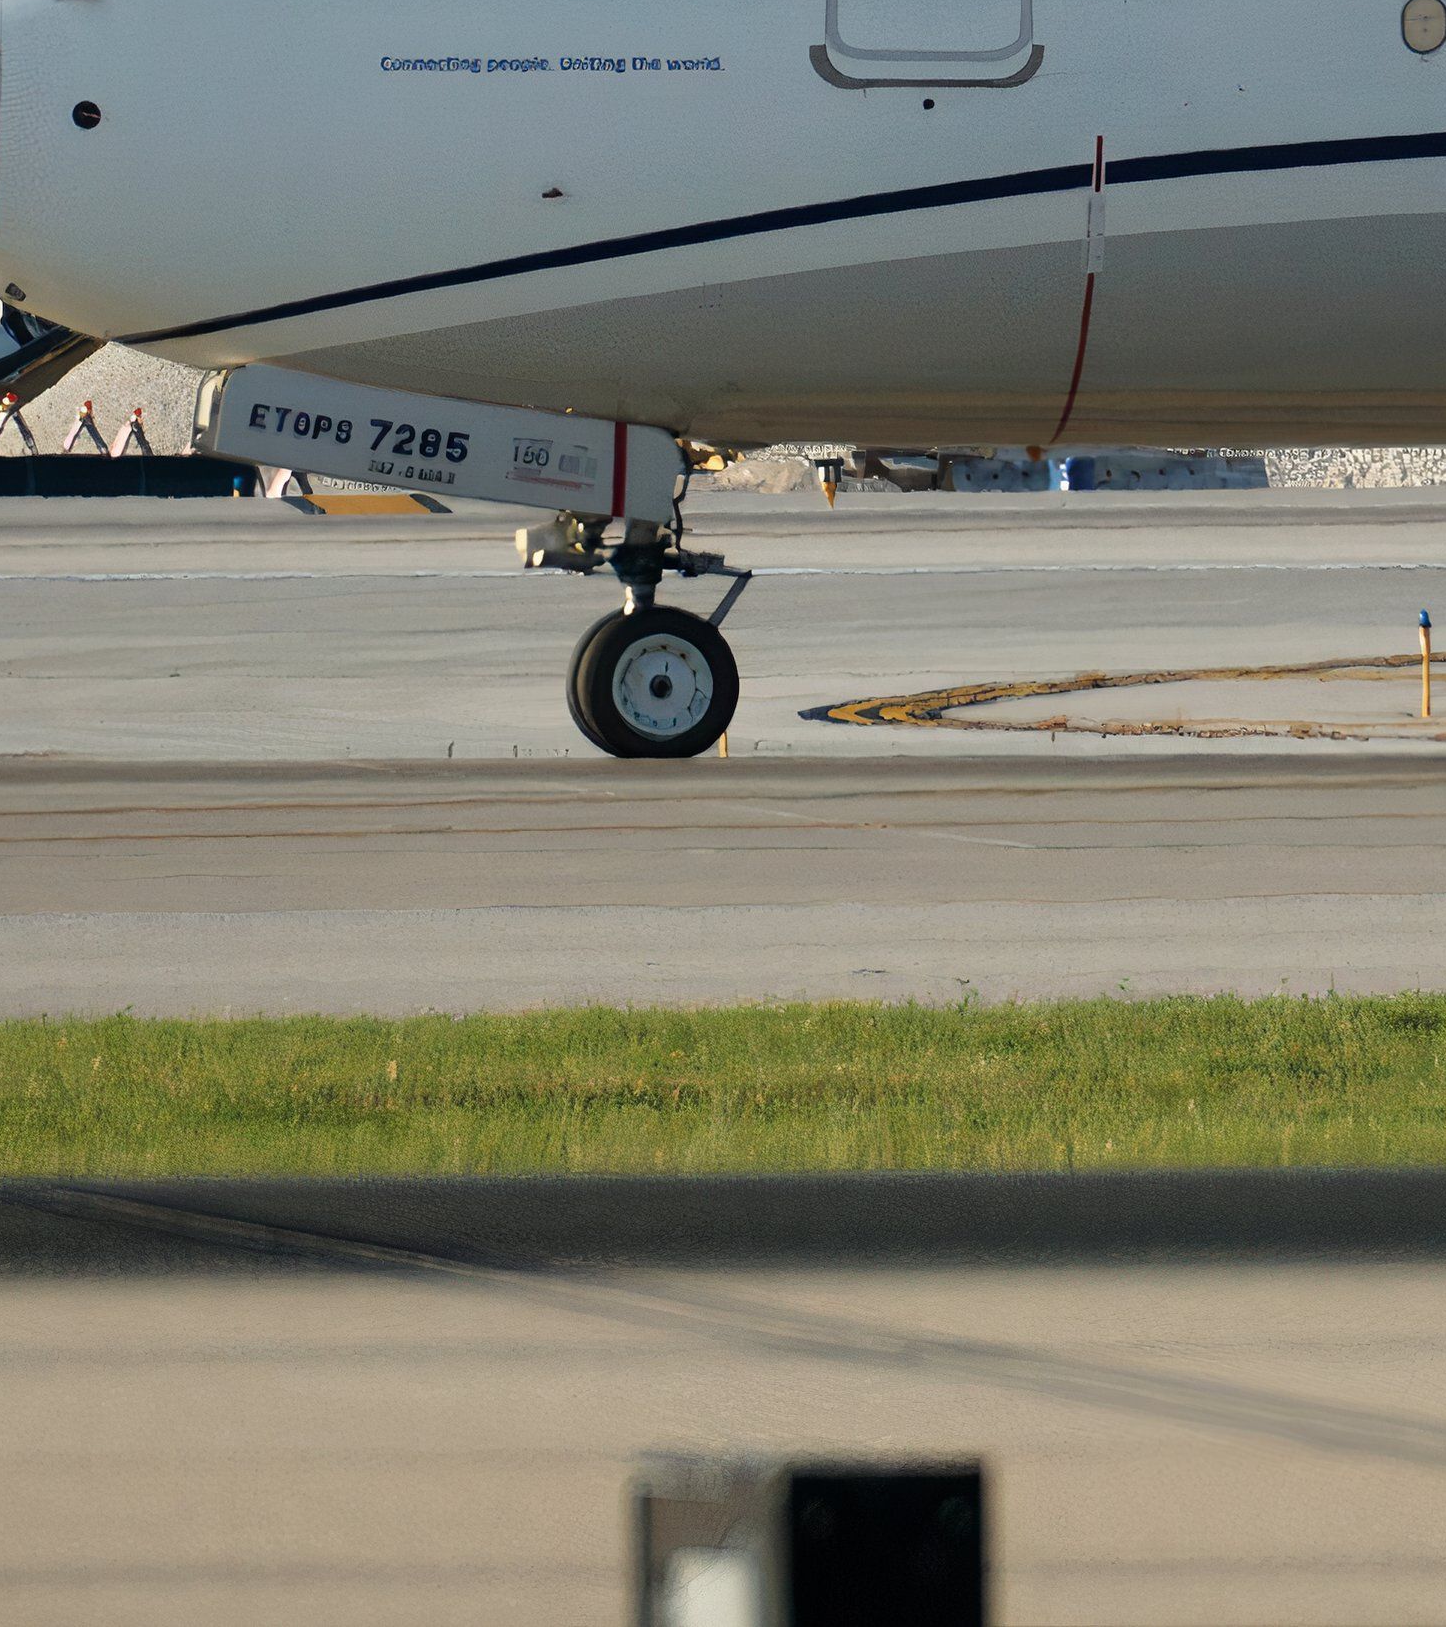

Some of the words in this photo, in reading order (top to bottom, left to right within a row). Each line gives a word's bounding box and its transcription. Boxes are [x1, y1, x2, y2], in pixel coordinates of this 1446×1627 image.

[380, 56, 482, 73] Connecting
[632, 56, 662, 72] the
[248, 403, 353, 444] ETOPS
[368, 418, 471, 464] 7285
